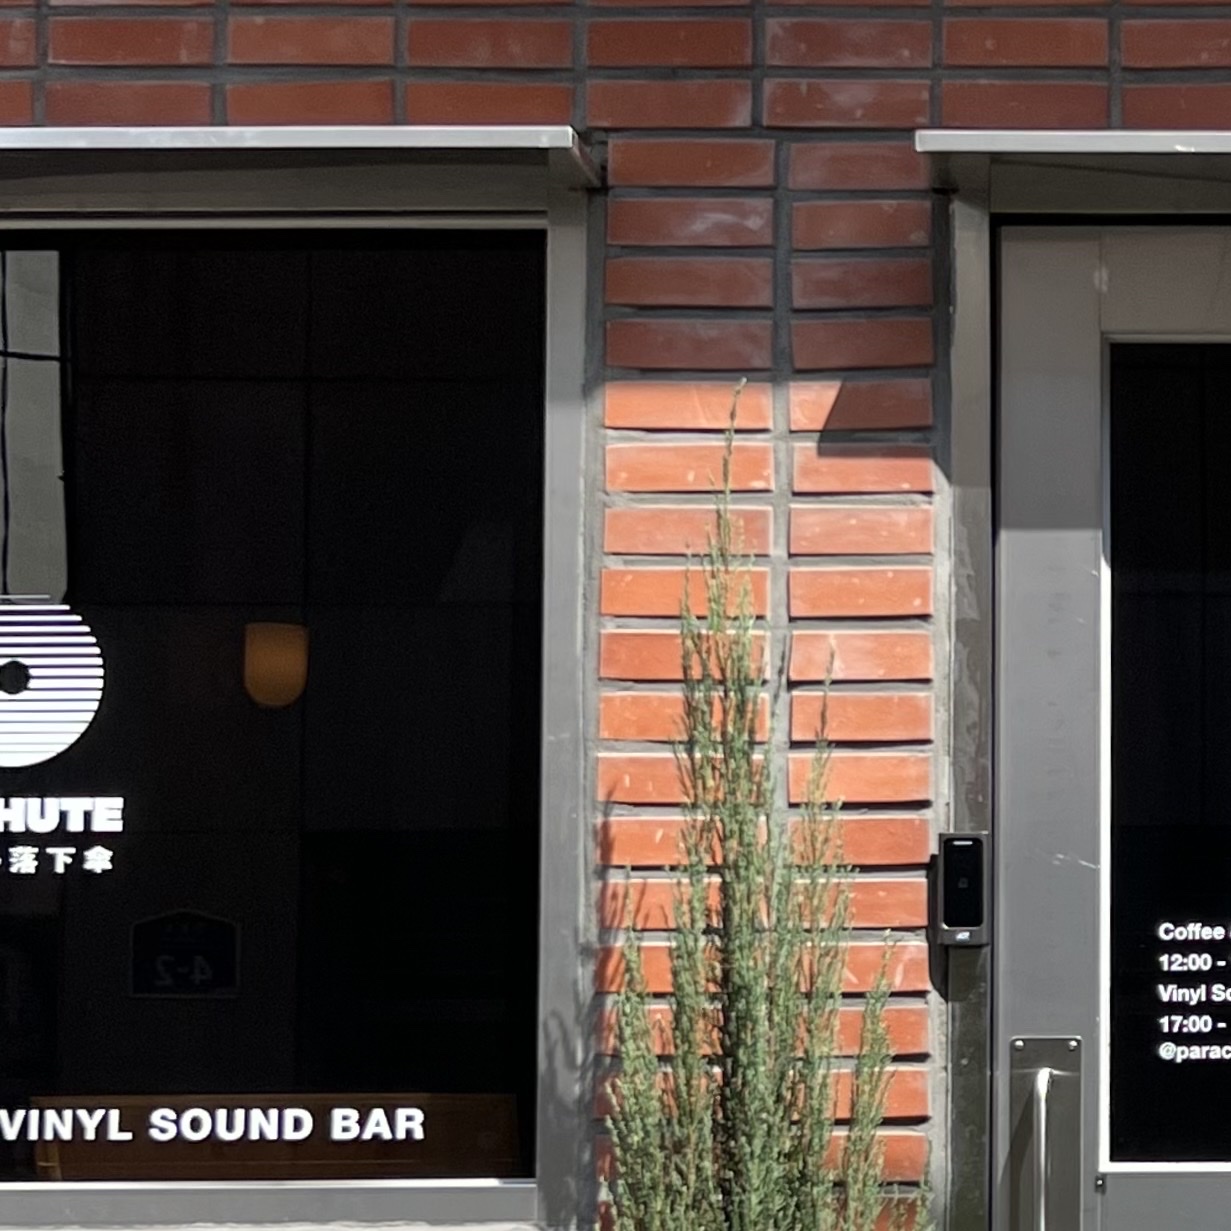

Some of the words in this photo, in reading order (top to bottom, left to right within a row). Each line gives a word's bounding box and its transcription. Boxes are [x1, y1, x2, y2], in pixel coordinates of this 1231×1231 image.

[0, 796, 125, 834] HUTE
[0, 845, 114, 874] 落下傘
[1157, 921, 1226, 941] Coffee
[1157, 952, 1213, 972] 12:00
[1157, 983, 1207, 1006] Vinyl
[1157, 1014, 1213, 1033] 17:00
[0, 1108, 133, 1141] VINYL
[148, 1107, 314, 1142] SOUND
[330, 1107, 425, 1141] BAR
